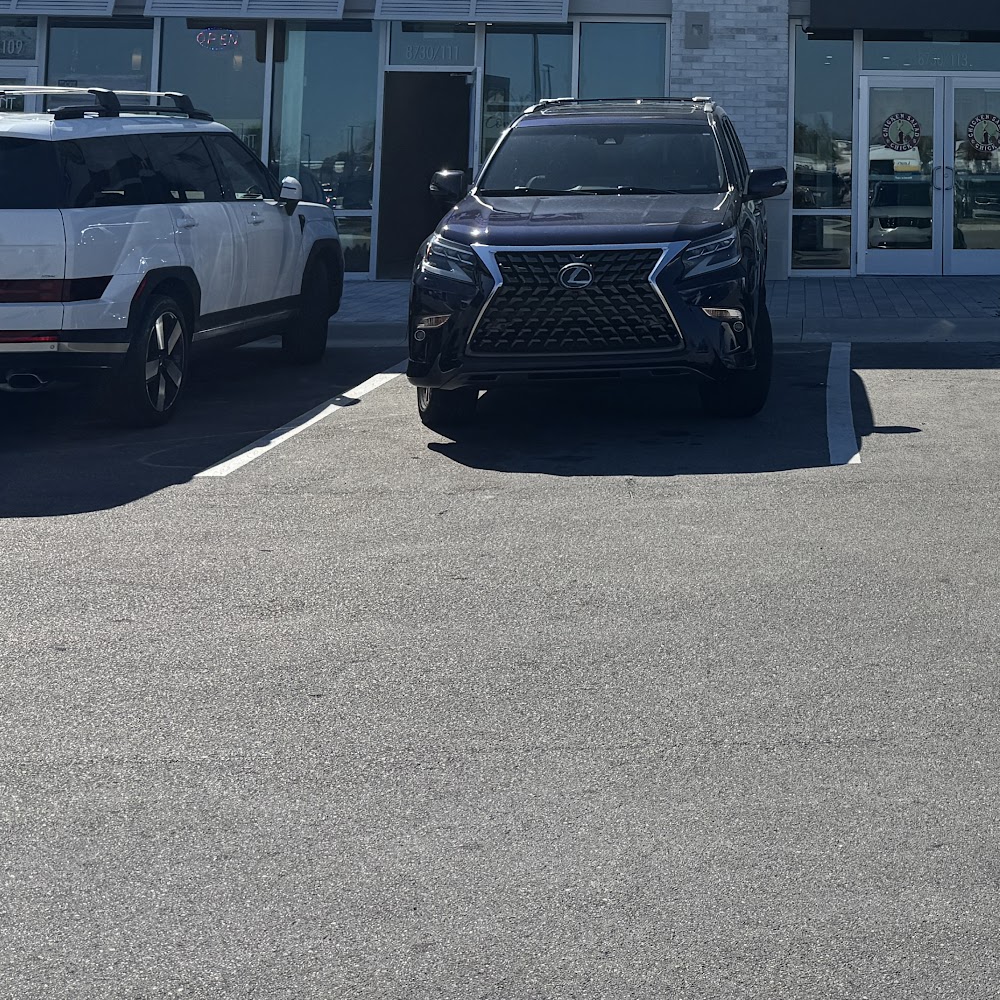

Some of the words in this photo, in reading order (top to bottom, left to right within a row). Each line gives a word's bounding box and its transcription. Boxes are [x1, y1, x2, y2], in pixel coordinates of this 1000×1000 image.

[196, 31, 239, 46] OPEN
[882, 113, 905, 138] CHICKEN
[907, 114, 921, 138] SALAD
[967, 114, 990, 139] CHICKEN
[889, 142, 913, 151] CHICK
[974, 143, 998, 152] CHICK
